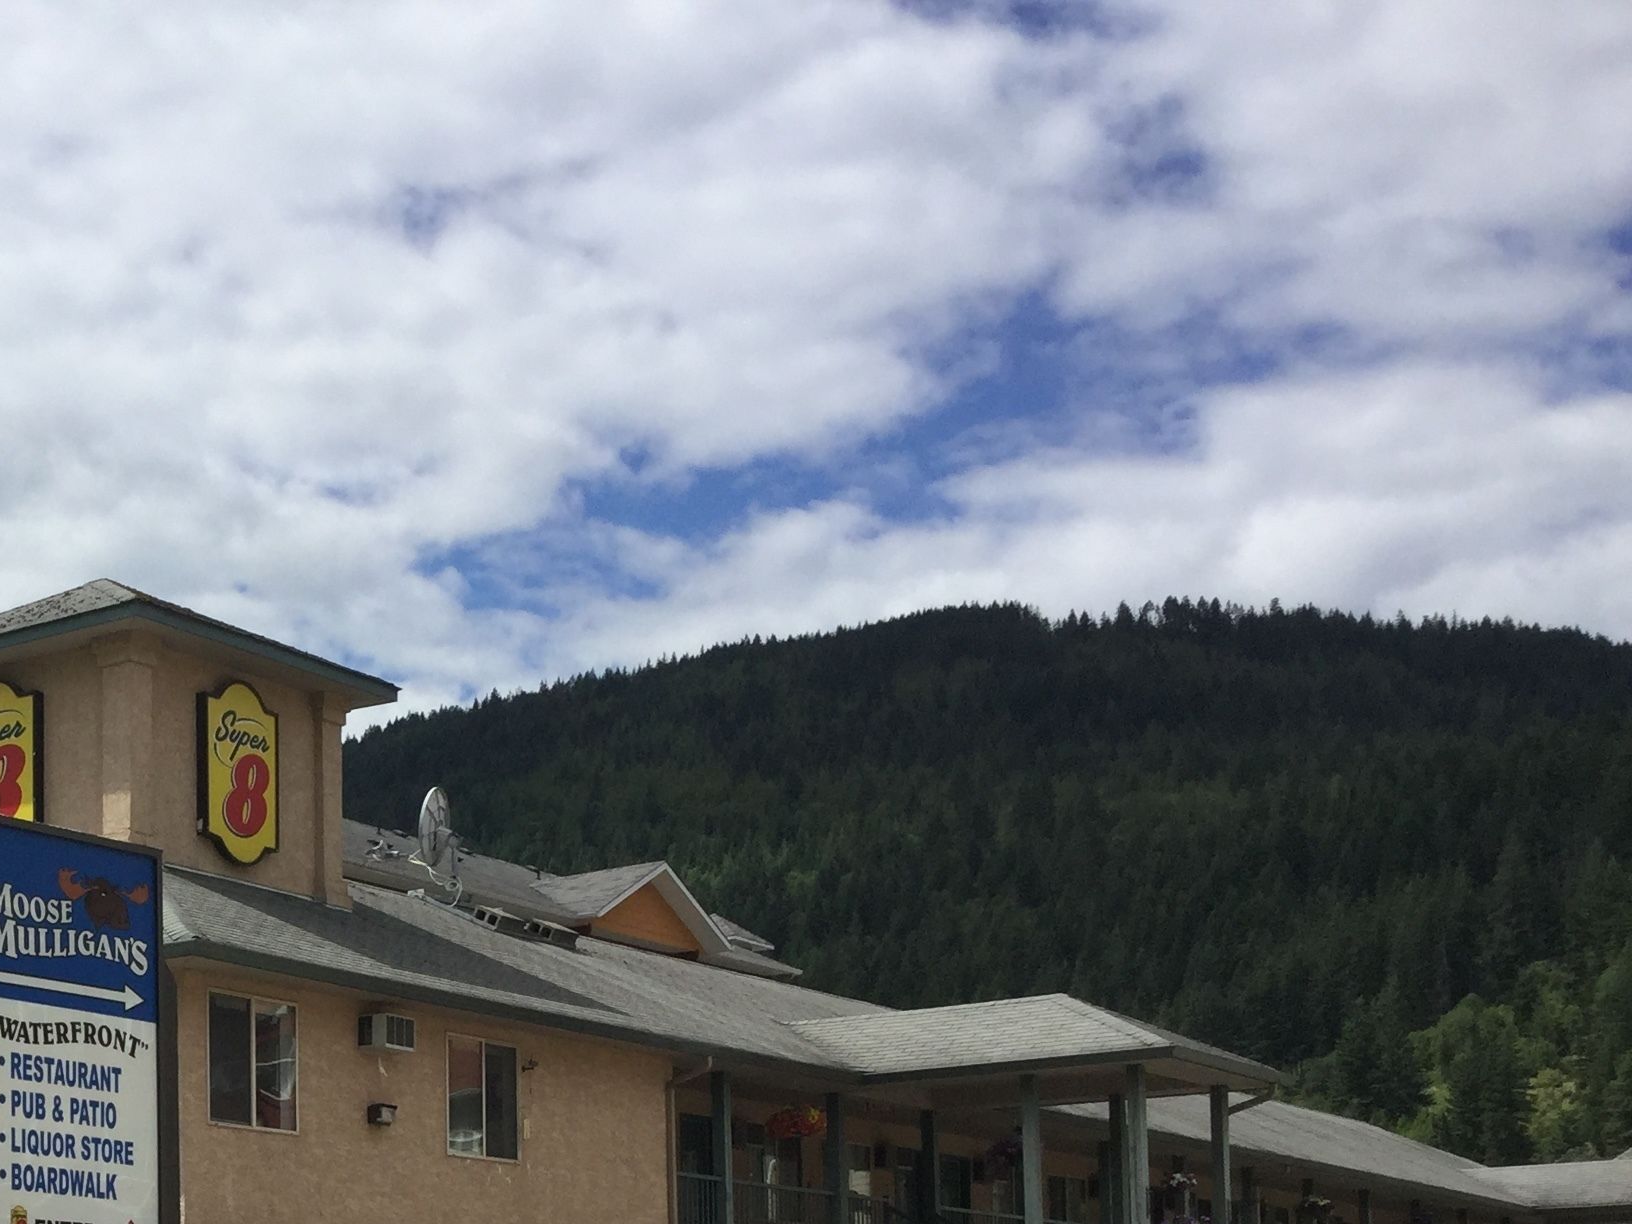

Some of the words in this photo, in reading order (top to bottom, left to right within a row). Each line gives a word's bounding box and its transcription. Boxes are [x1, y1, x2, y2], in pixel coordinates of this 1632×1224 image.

[215, 710, 269, 761] Super
[222, 753, 270, 838] 8
[10, 1052, 122, 1093] RESTAURANT
[11, 1090, 46, 1120] PUB
[52, 1095, 64, 1122] &
[70, 1097, 117, 1129] PATIO
[11, 1127, 76, 1159] LIQUOR
[81, 1136, 134, 1166] STORE
[11, 1163, 117, 1200] BOARDWALK
